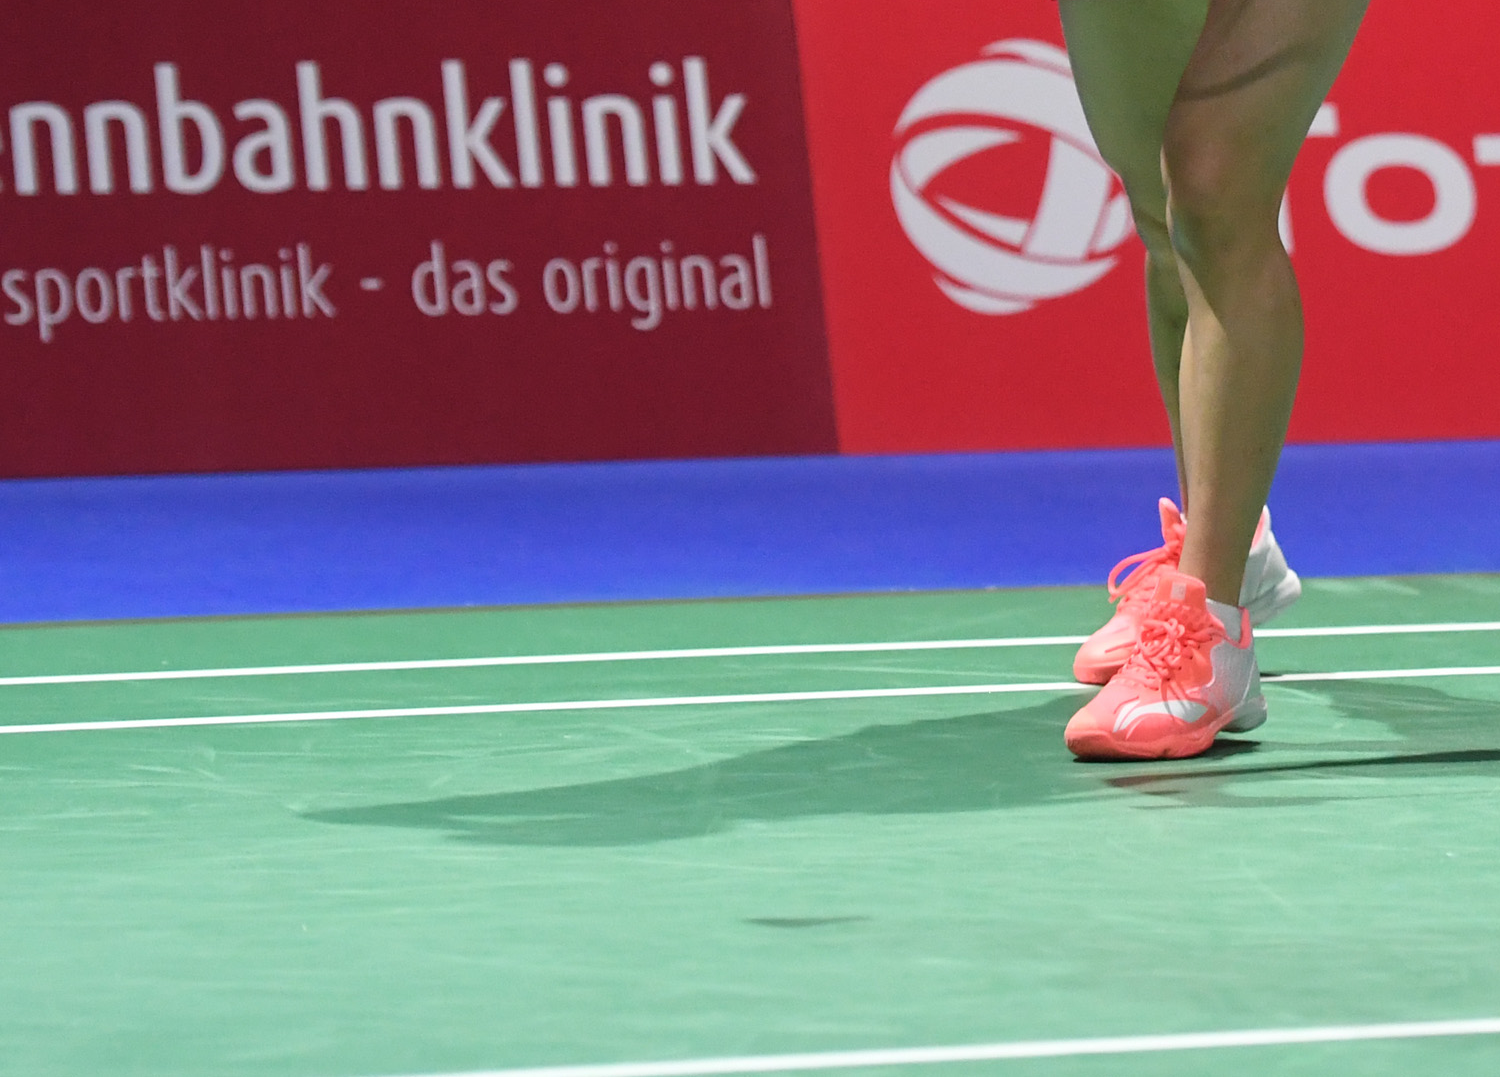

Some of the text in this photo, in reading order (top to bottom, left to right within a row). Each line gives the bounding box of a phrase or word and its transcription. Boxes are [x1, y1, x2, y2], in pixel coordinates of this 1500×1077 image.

[0, 57, 756, 196] nnbahnklinik
[2, 244, 335, 343] sportklinik
[411, 241, 519, 317] das
[542, 234, 772, 331] original
